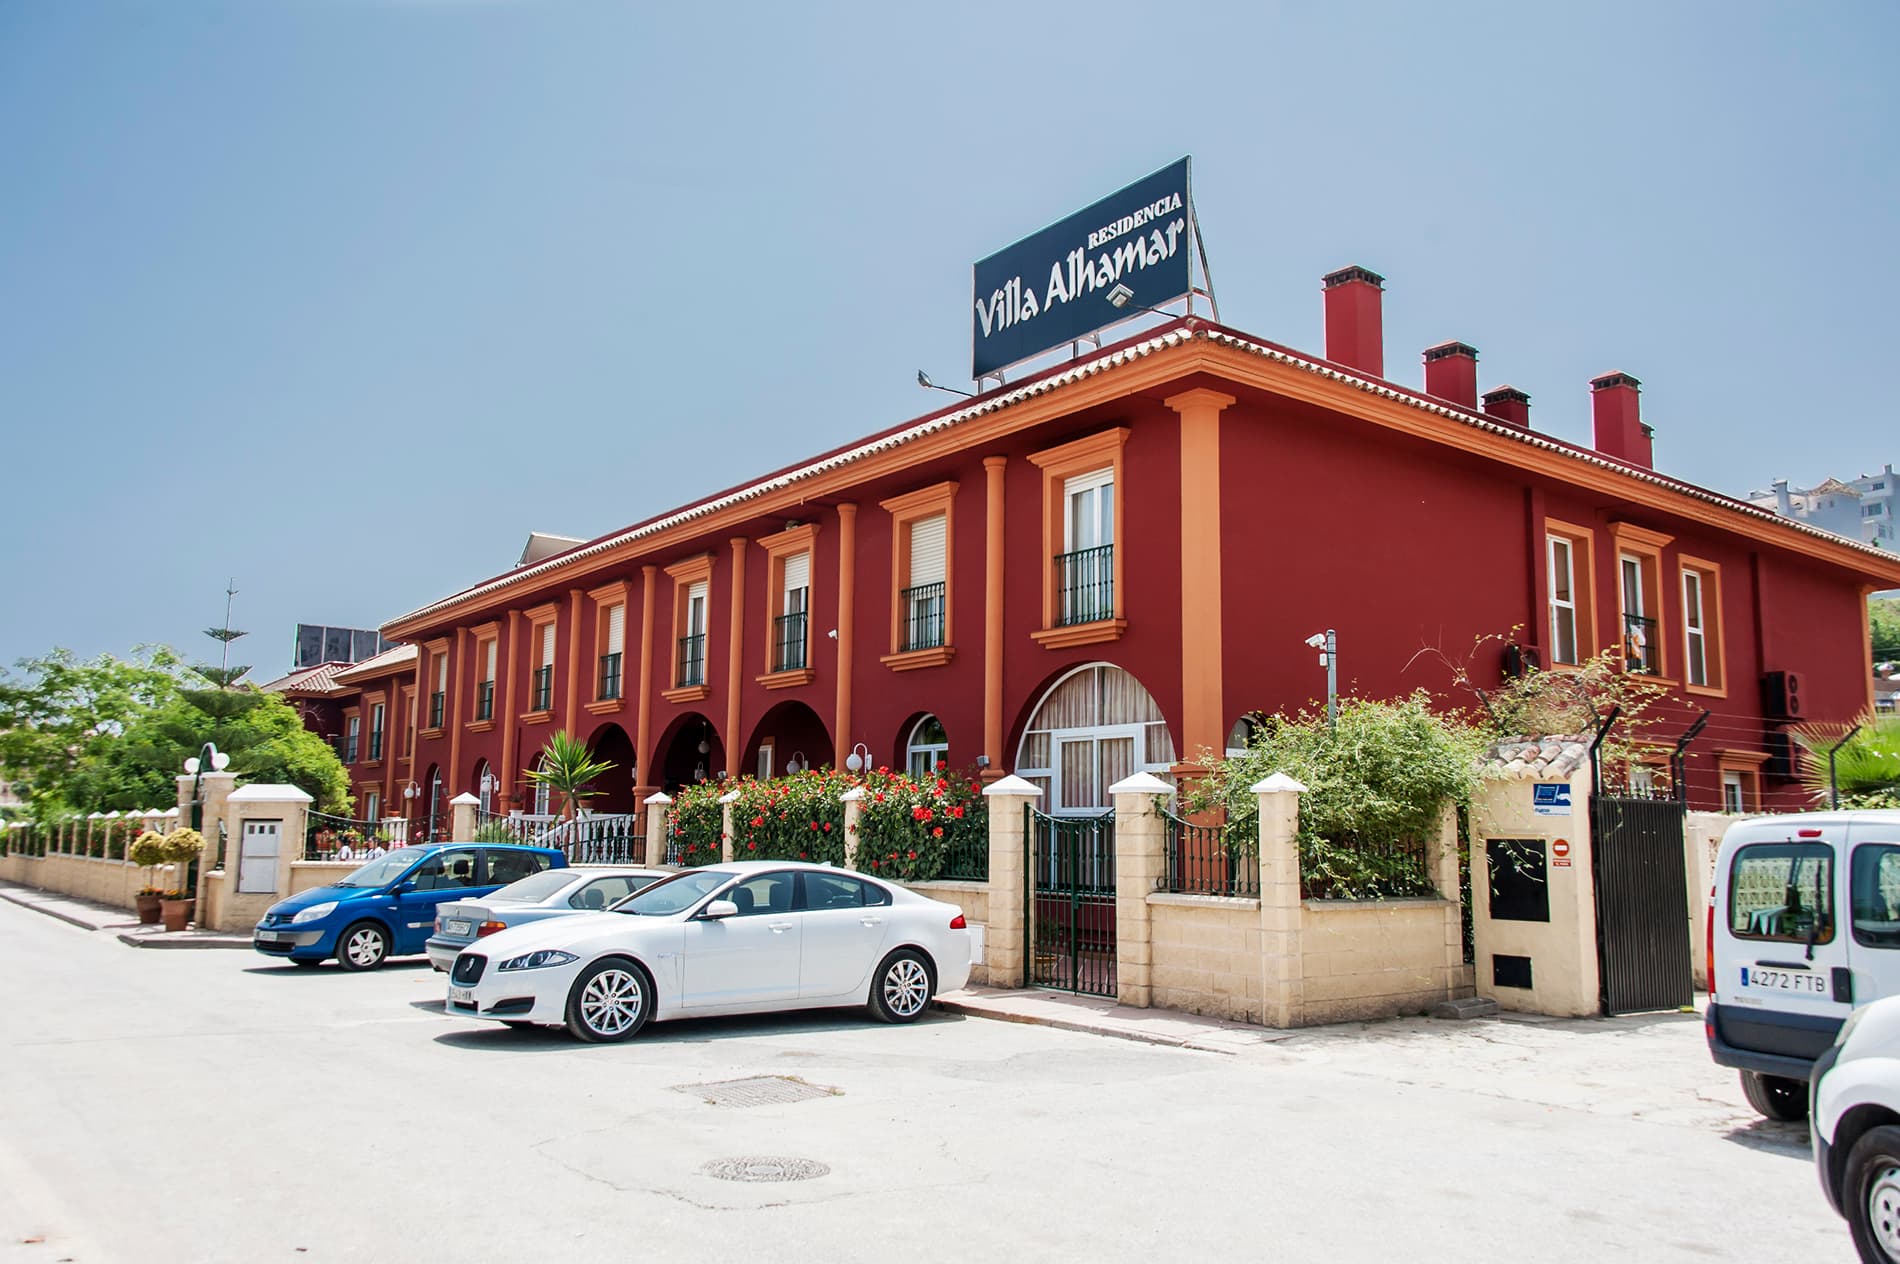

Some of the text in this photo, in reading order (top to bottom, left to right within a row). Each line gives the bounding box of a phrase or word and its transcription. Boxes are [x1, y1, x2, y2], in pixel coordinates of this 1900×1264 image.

[1088, 192, 1183, 250] RESIDENCIA
[975, 217, 1185, 338] Villa Alhamar
[1751, 970, 1825, 992] 4272 FTB
